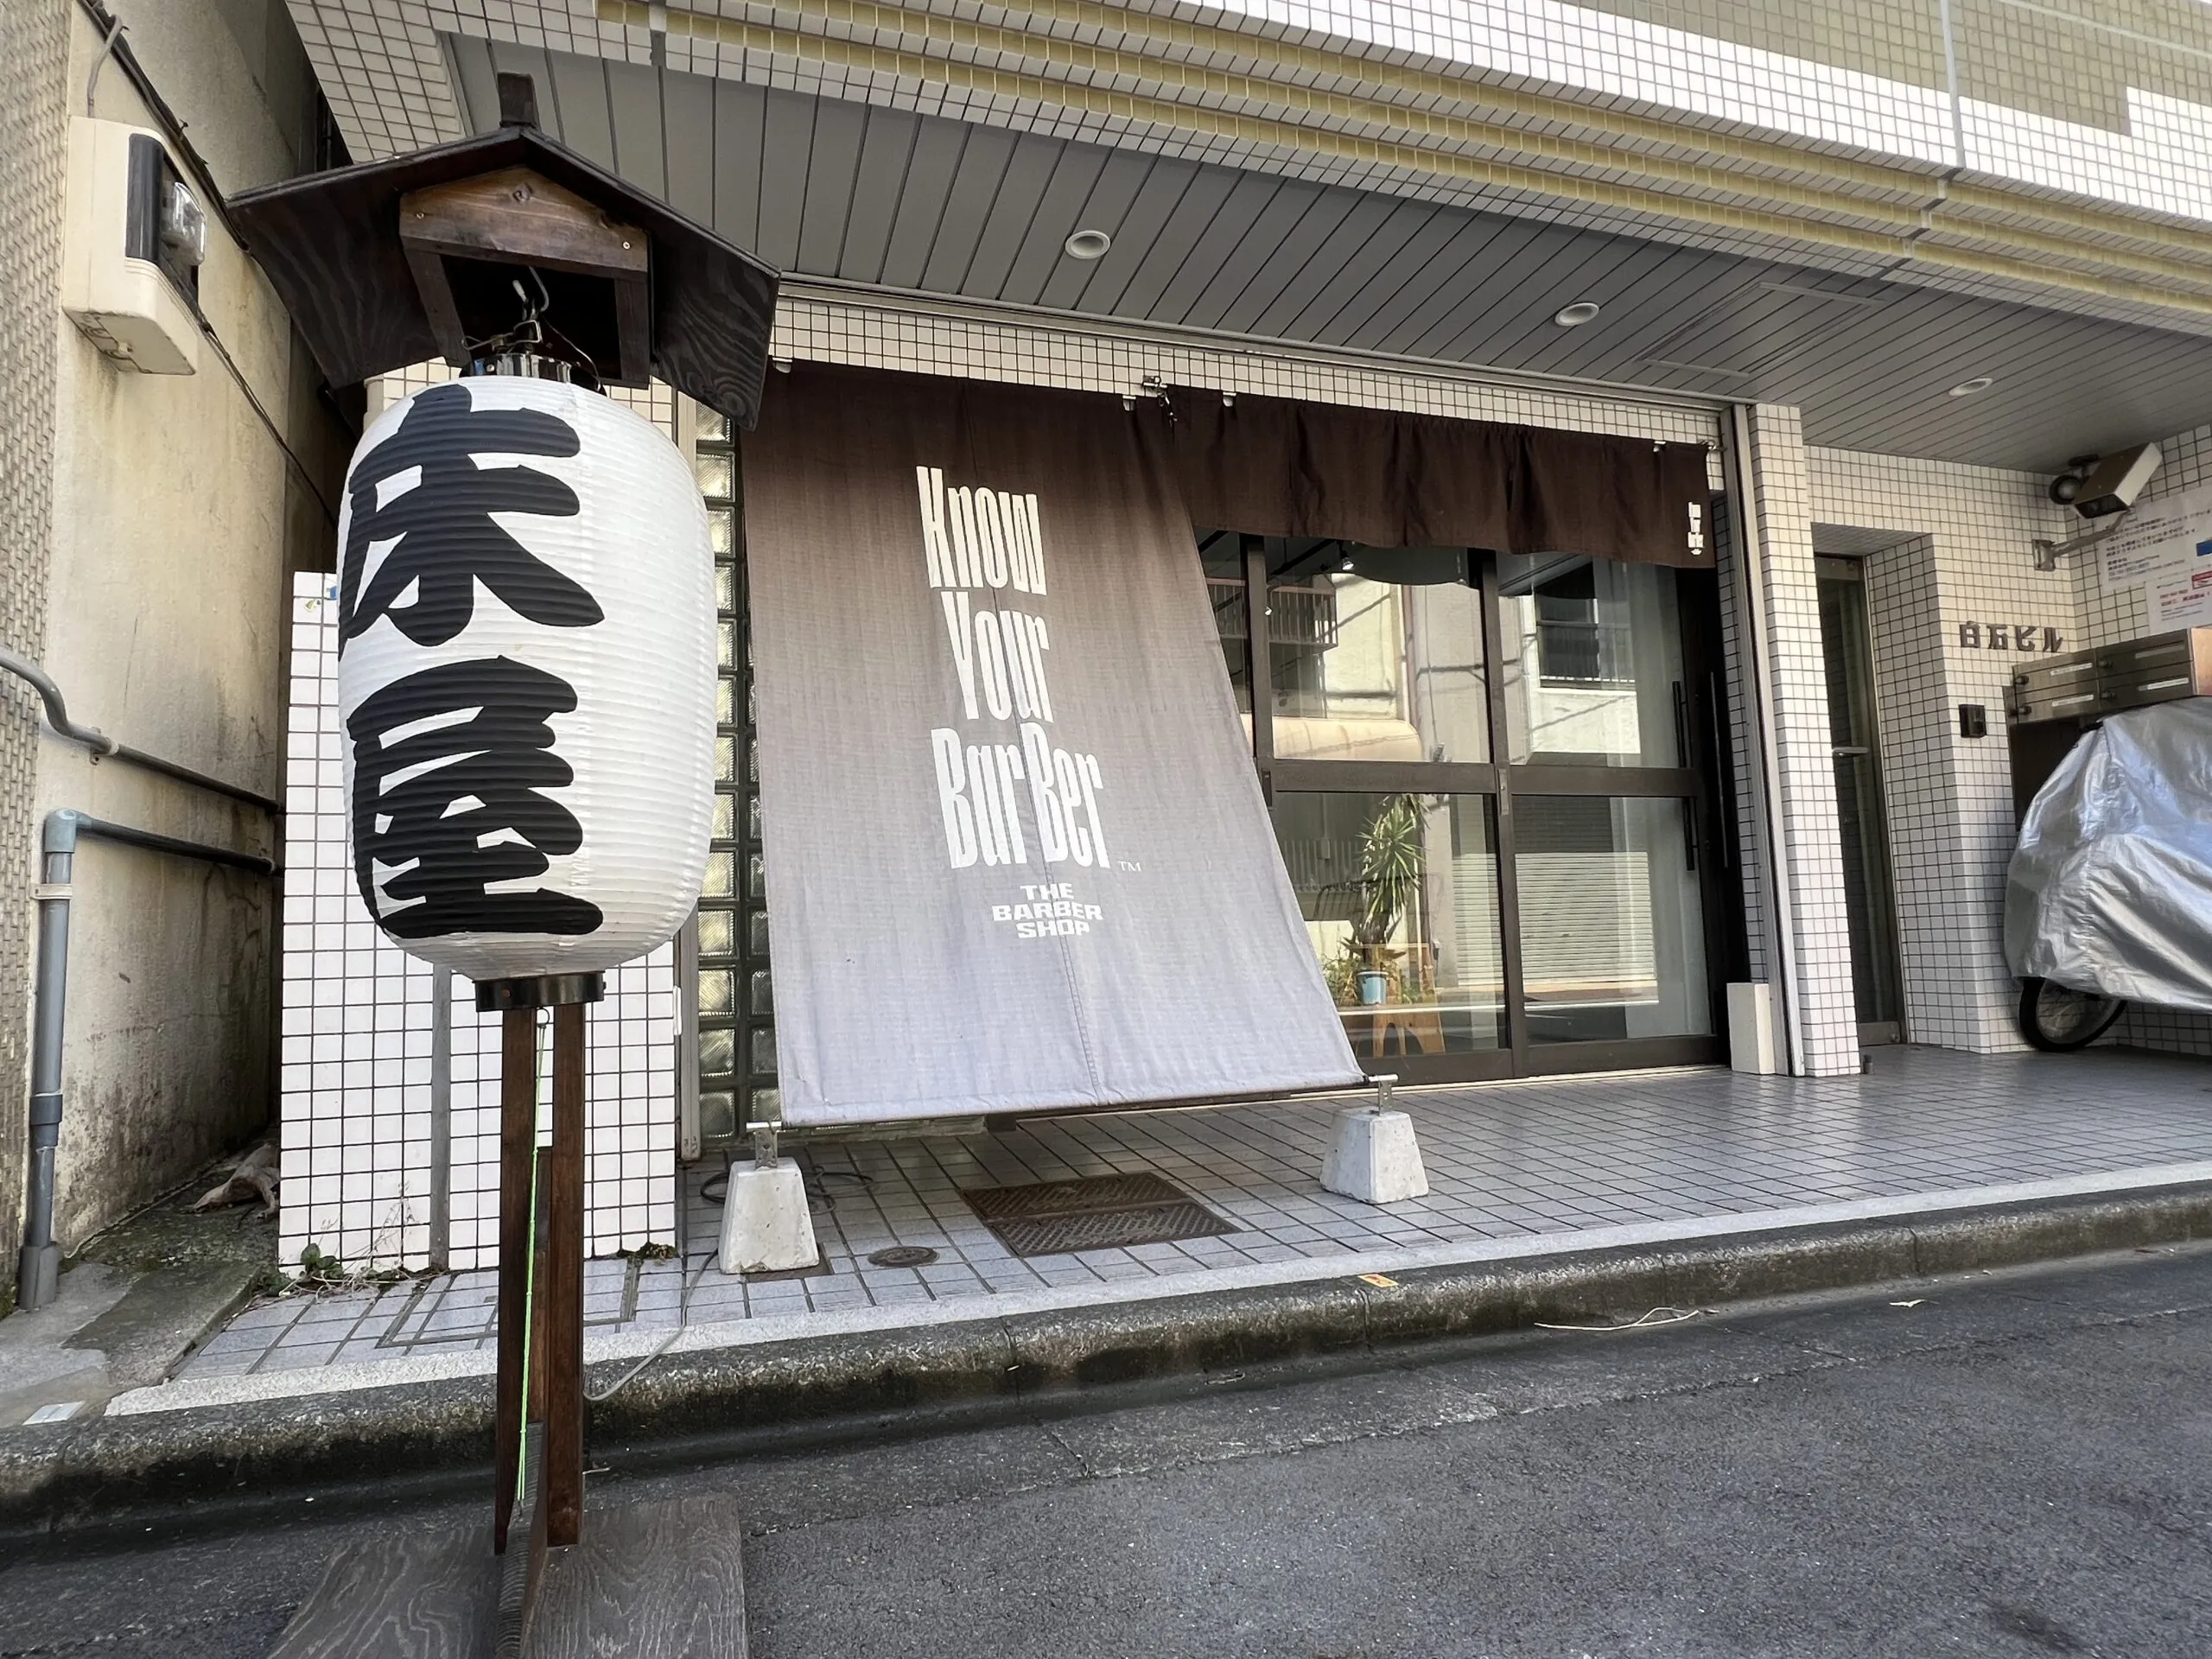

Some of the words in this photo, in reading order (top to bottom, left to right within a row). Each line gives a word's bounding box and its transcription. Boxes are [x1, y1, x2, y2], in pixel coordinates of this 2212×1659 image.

[916, 466, 1047, 595] Know
[340, 383, 605, 939] 床屋
[940, 591, 1053, 723] Your
[991, 900, 1104, 922] BARBER
[1015, 918, 1090, 938] SHOP
[1020, 882, 1075, 900] THE
